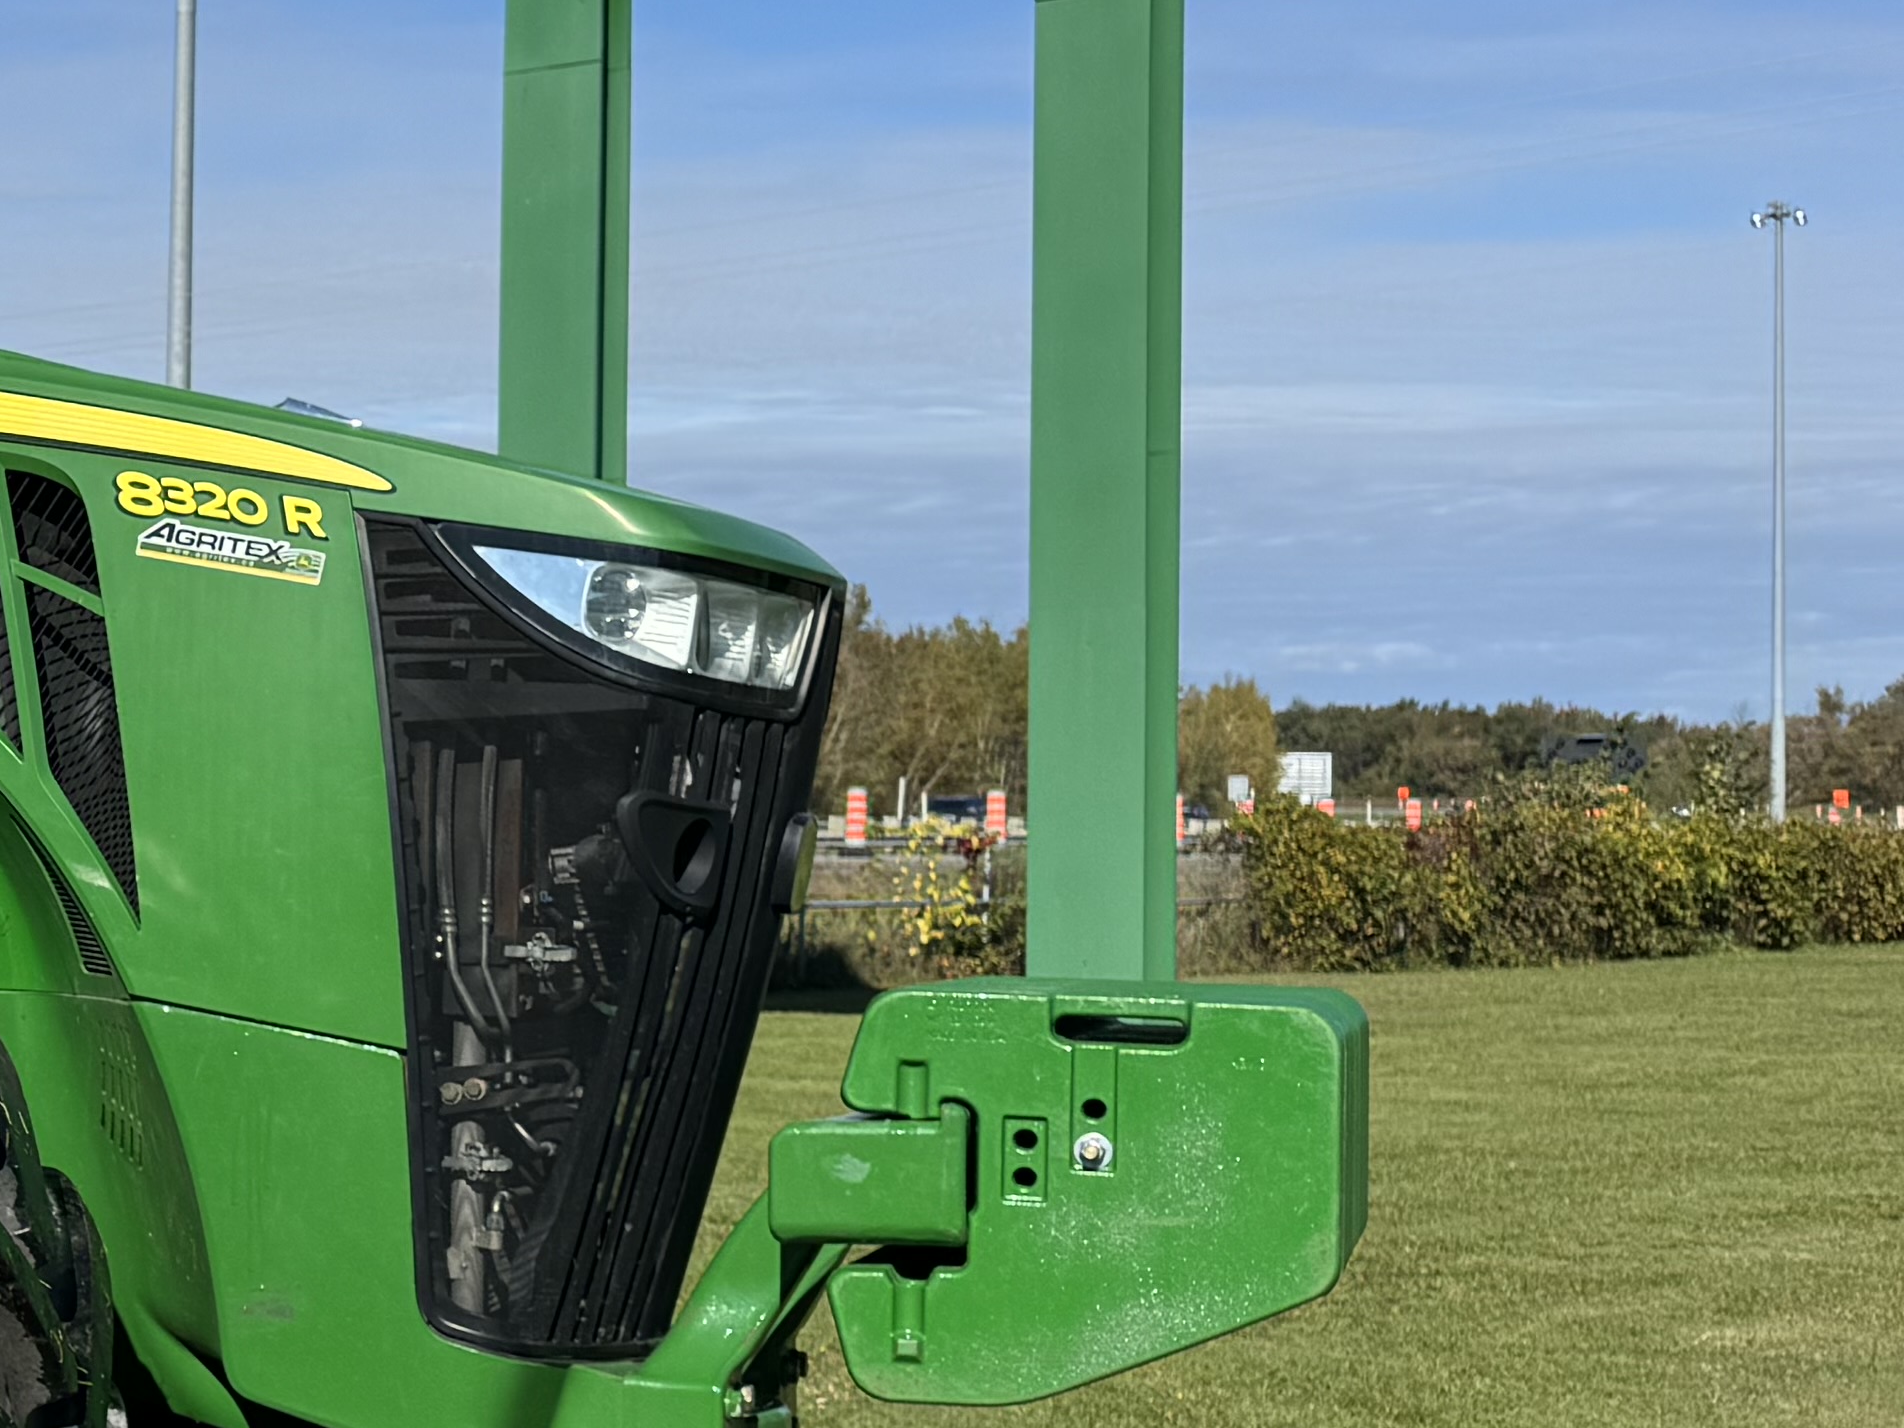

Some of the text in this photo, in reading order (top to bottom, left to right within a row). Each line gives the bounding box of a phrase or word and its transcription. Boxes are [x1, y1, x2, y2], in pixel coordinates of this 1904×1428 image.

[115, 470, 329, 540] 8320 R
[144, 522, 287, 563] AGRITEX
